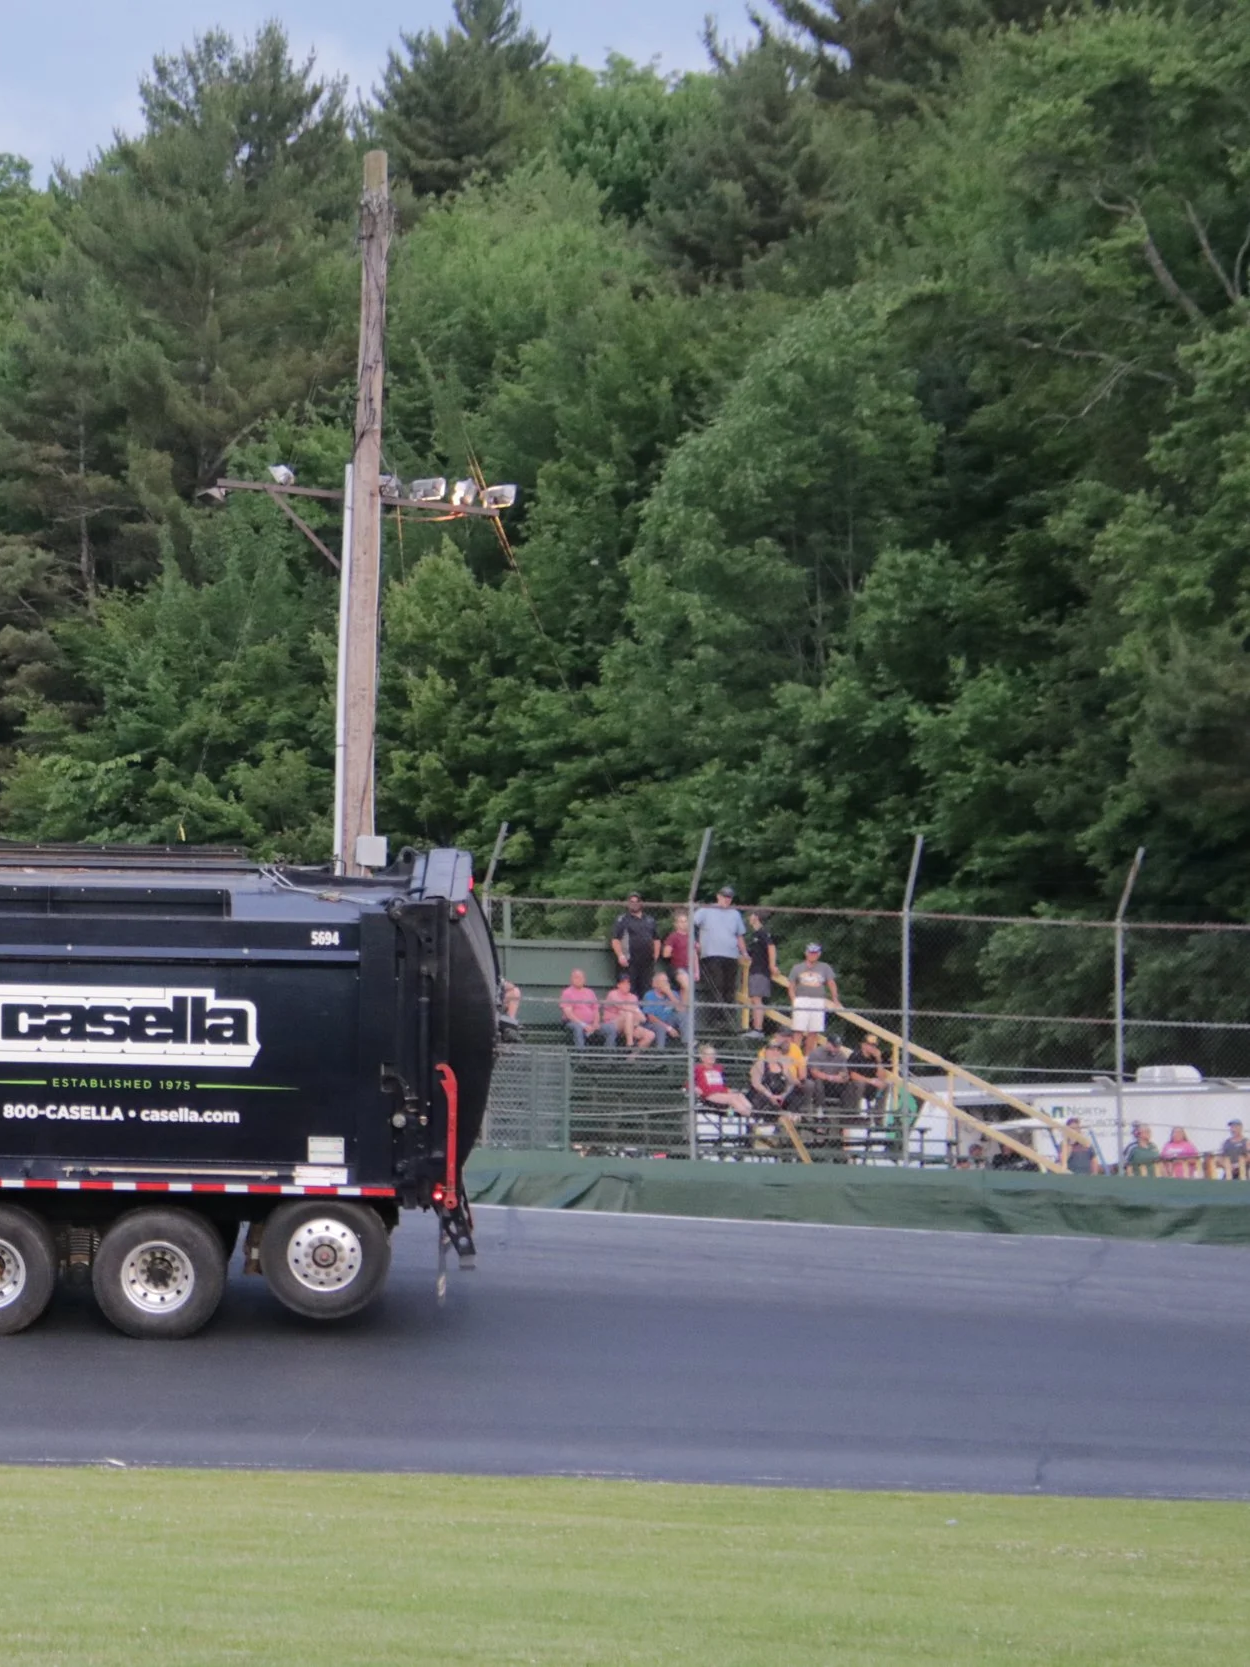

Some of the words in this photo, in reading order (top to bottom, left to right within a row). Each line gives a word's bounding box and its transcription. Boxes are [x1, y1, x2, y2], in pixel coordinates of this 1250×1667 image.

[311, 930, 340, 946] 5694
[1, 996, 251, 1046] casella
[52, 1078, 152, 1090] ESTABLISHED
[159, 1080, 191, 1091] 1975
[2, 1103, 124, 1121] 800-CASELLA
[140, 1107, 240, 1124] casella.com
